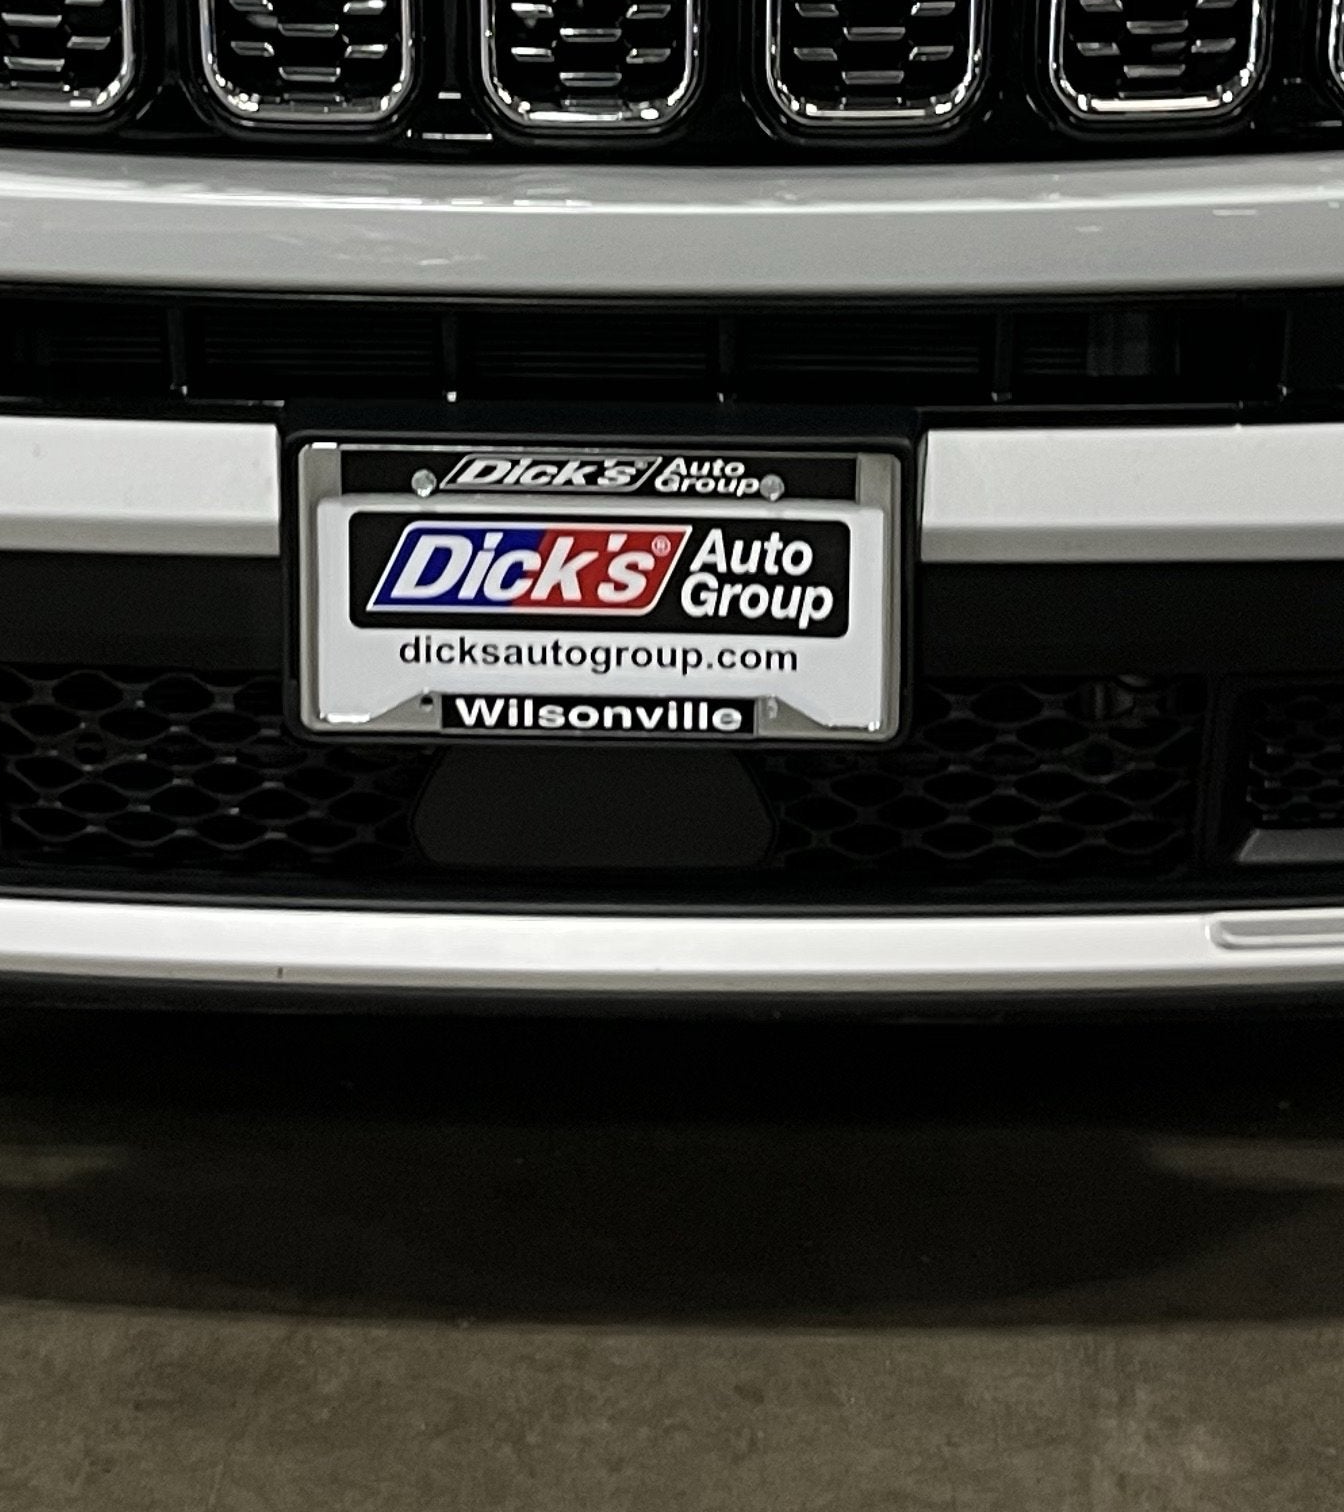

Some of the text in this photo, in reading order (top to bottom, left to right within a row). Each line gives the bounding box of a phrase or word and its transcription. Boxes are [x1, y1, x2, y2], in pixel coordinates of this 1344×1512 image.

[654, 473, 760, 498] Group
[663, 456, 746, 477] Auto
[689, 528, 814, 576] Auto
[680, 571, 835, 629] Group
[398, 635, 799, 676] dicksautogroup.com
[455, 697, 744, 732] Wilsonville
